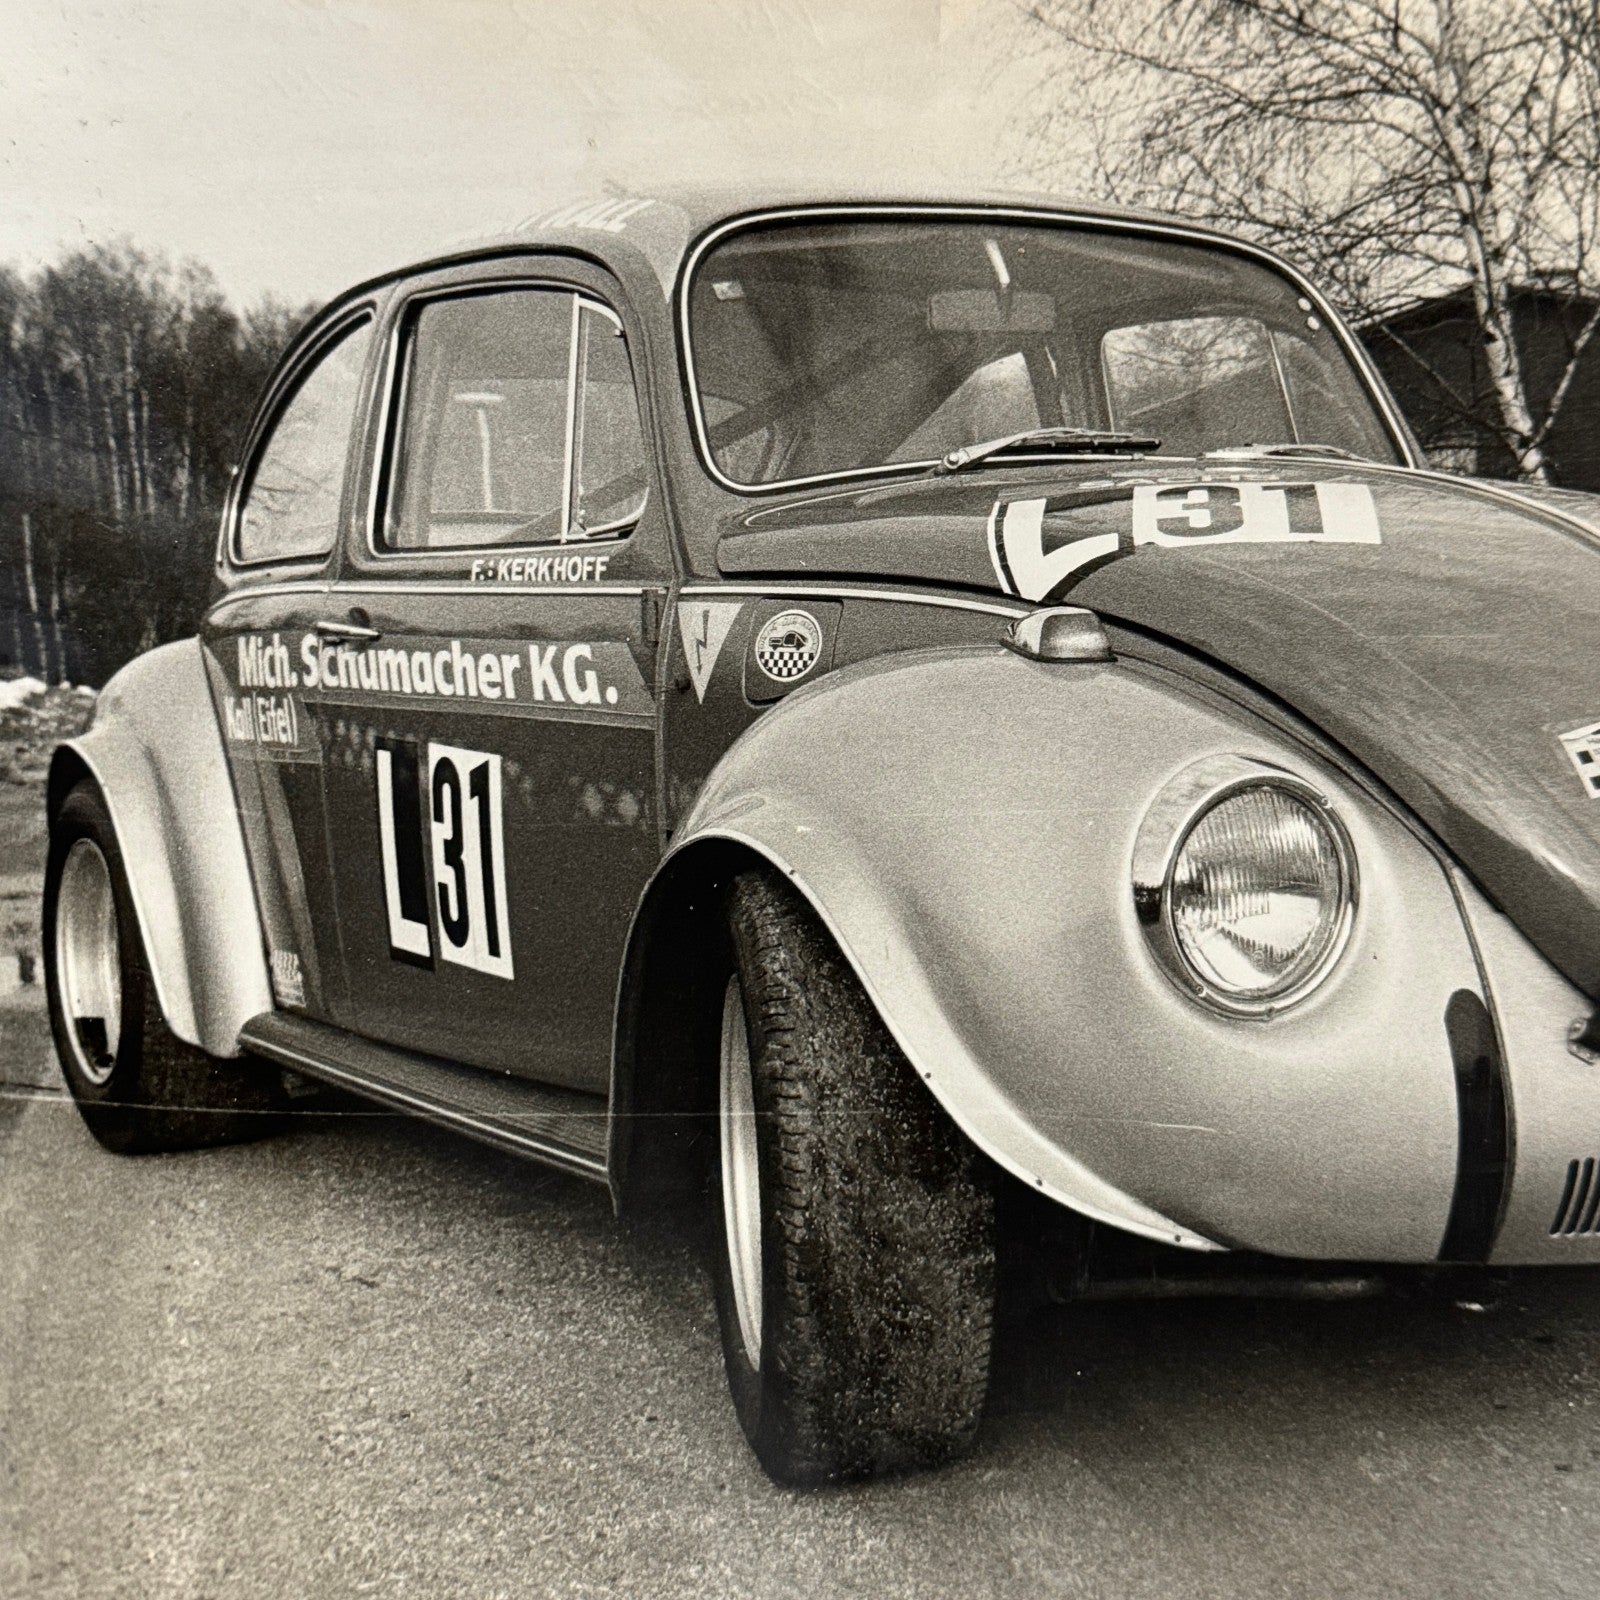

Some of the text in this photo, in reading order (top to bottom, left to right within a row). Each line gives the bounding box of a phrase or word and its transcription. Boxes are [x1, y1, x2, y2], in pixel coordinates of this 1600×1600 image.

[498, 555, 610, 582] KERKHOFF
[1003, 485, 1325, 602] L 31
[237, 632, 618, 705] Mich. Schumacher KG.
[252, 690, 298, 747] (Eifel)
[376, 749, 502, 959] L 31
